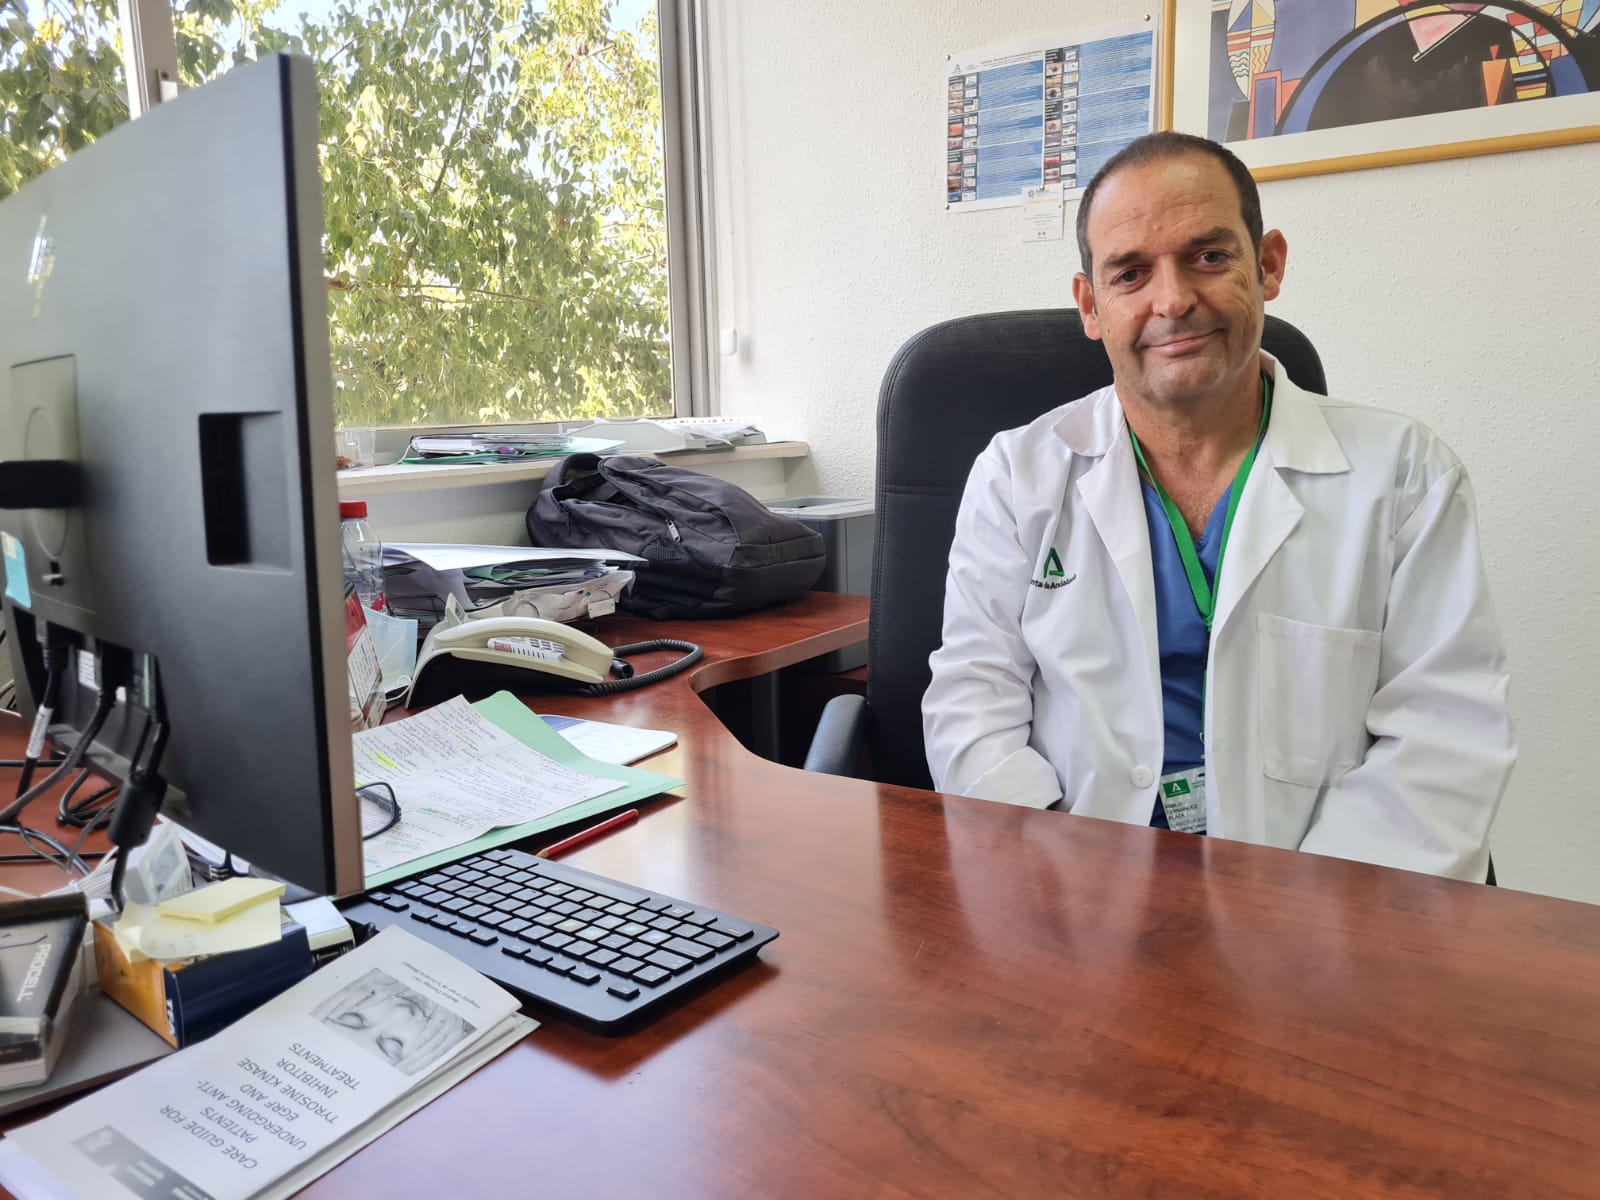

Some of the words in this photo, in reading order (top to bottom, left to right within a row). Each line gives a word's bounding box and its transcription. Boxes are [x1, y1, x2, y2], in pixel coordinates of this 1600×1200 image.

[16, 943, 52, 1002] PROCELL
[236, 1057, 284, 1088] KINASE
[275, 1057, 339, 1099] INHIBITOR
[287, 1042, 361, 1091] TREATMENTS
[197, 1080, 231, 1101] ANTI-
[239, 1083, 270, 1102] AND
[278, 1083, 339, 1125] TYROSINE
[159, 1104, 188, 1124] FOR
[199, 1106, 259, 1144] PATIENTS
[225, 1098, 307, 1151] UNDERGOING
[263, 1101, 300, 1123] EGRF
[182, 1120, 225, 1148] GUIDE
[221, 1144, 258, 1170] CARE
